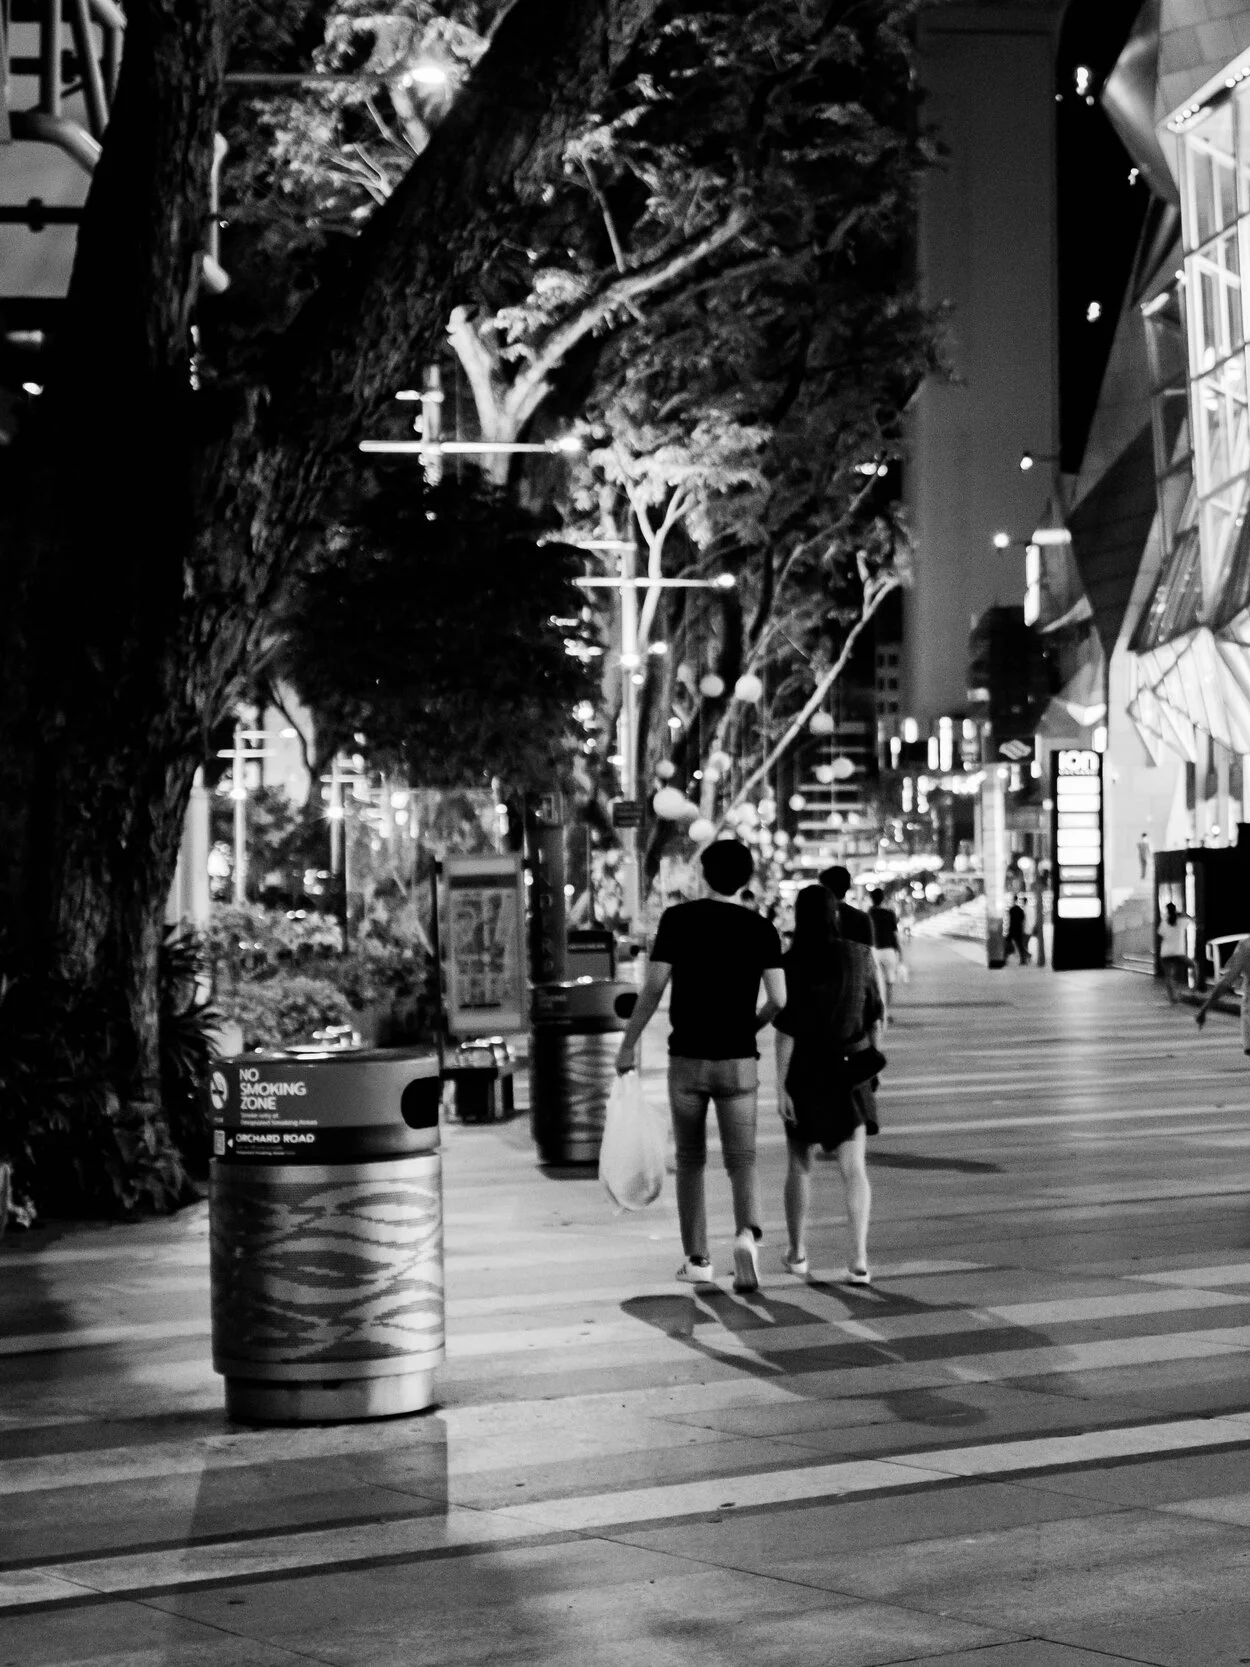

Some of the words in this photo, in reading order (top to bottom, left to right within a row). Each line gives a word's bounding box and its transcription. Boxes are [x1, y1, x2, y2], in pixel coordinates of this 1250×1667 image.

[240, 1068, 259, 1081] NO
[240, 1082, 306, 1096] SMOKING
[240, 1096, 277, 1110] ZONE
[236, 1133, 281, 1143] ORCHARD
[283, 1133, 315, 1143] ROAD
